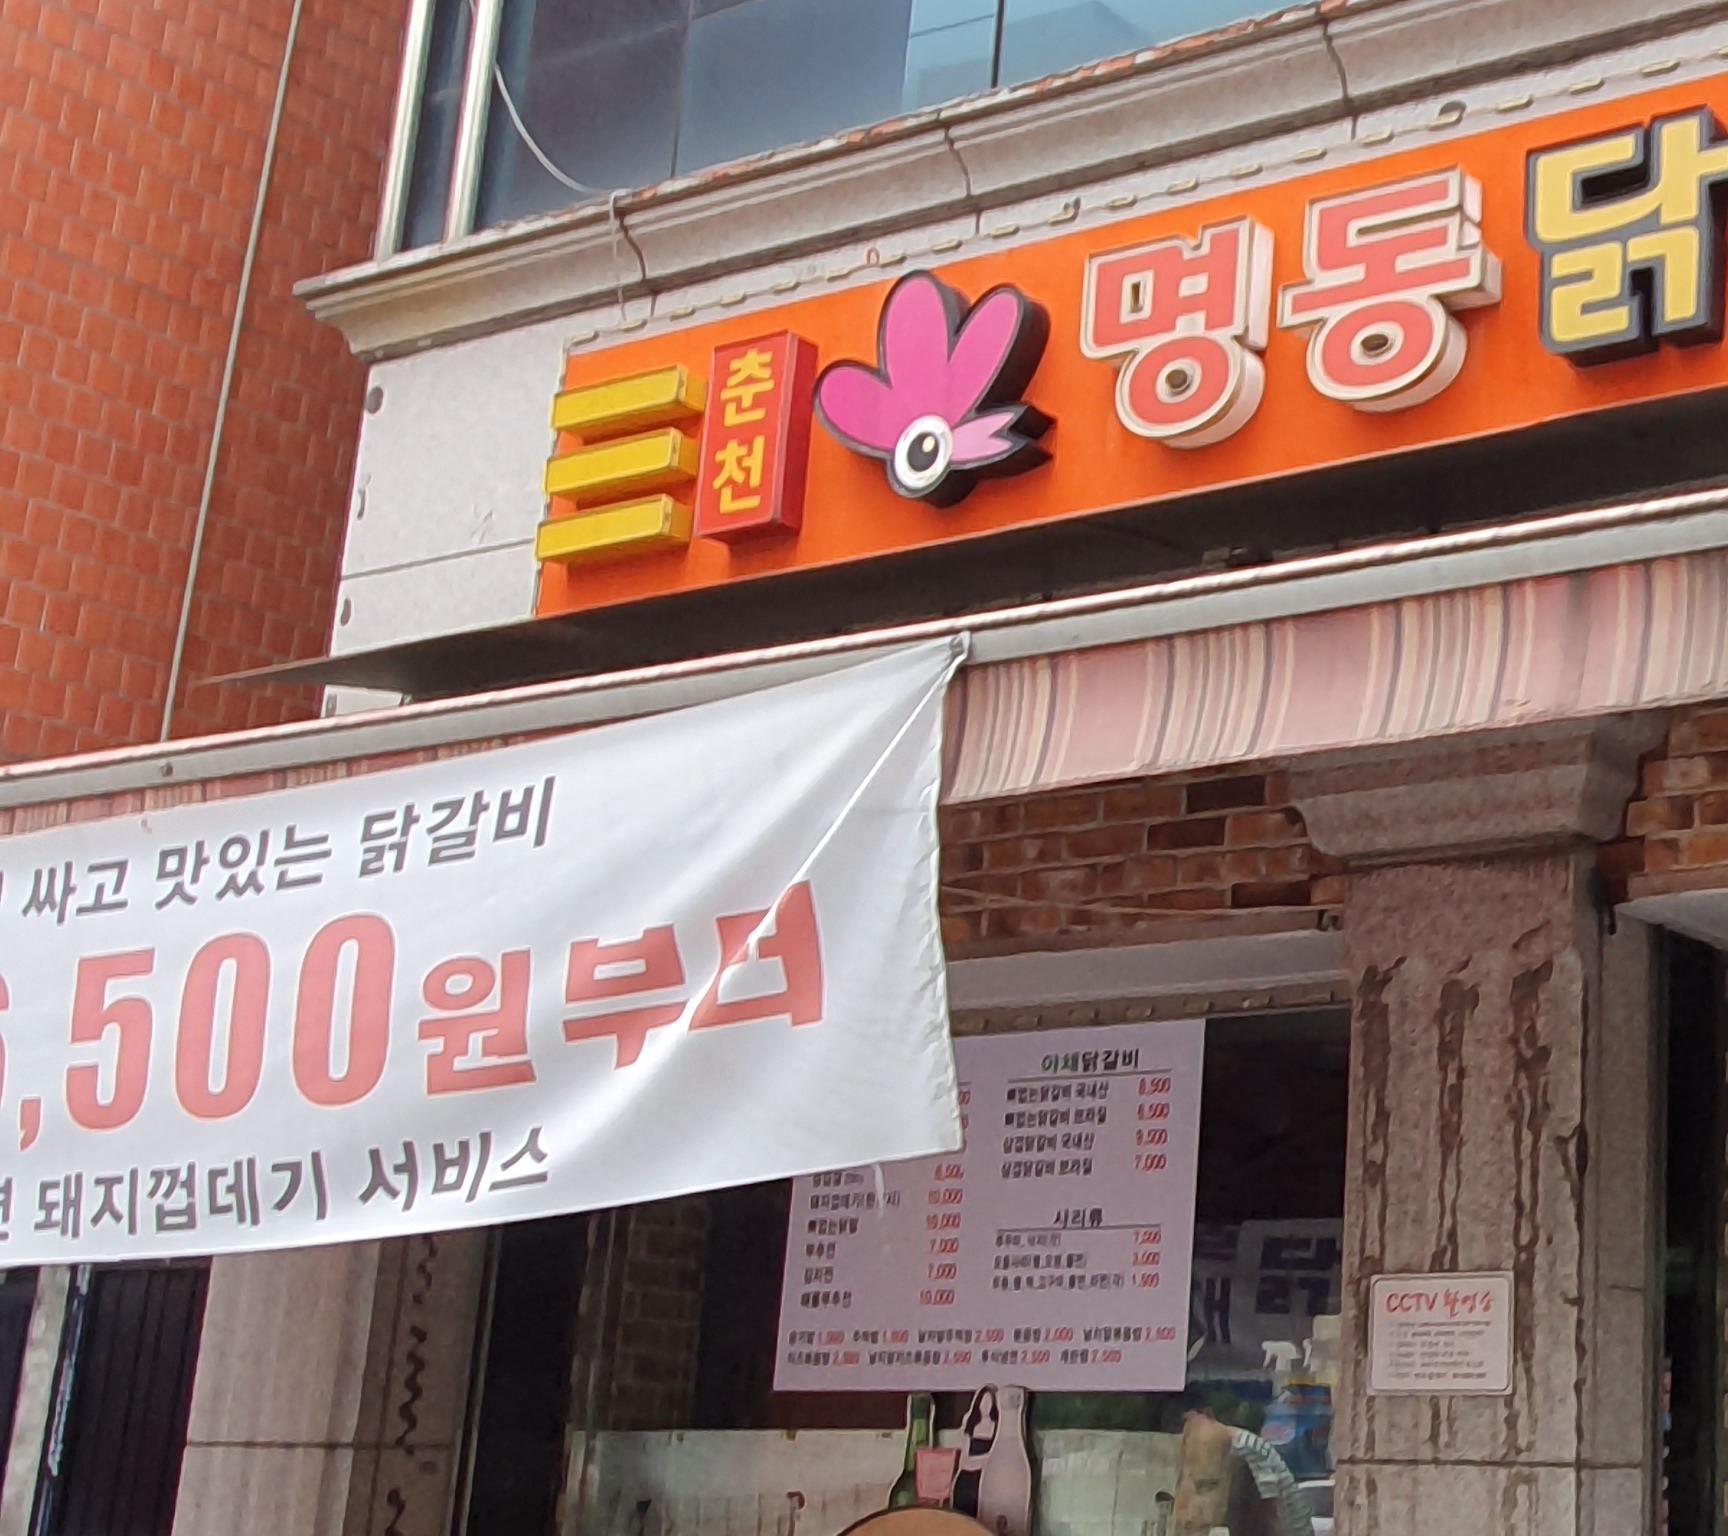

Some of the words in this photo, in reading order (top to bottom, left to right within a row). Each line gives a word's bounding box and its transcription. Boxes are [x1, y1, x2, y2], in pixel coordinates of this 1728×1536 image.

[712, 348, 775, 514] 춘천
[22, 858, 129, 925] 싸고
[154, 824, 333, 910] 맛있는
[358, 775, 556, 878] 닭갈비
[33, 1150, 328, 1239] 돼지껍데기
[358, 1125, 548, 1212] 서비스
[1385, 1291, 1438, 1314] CCTV
